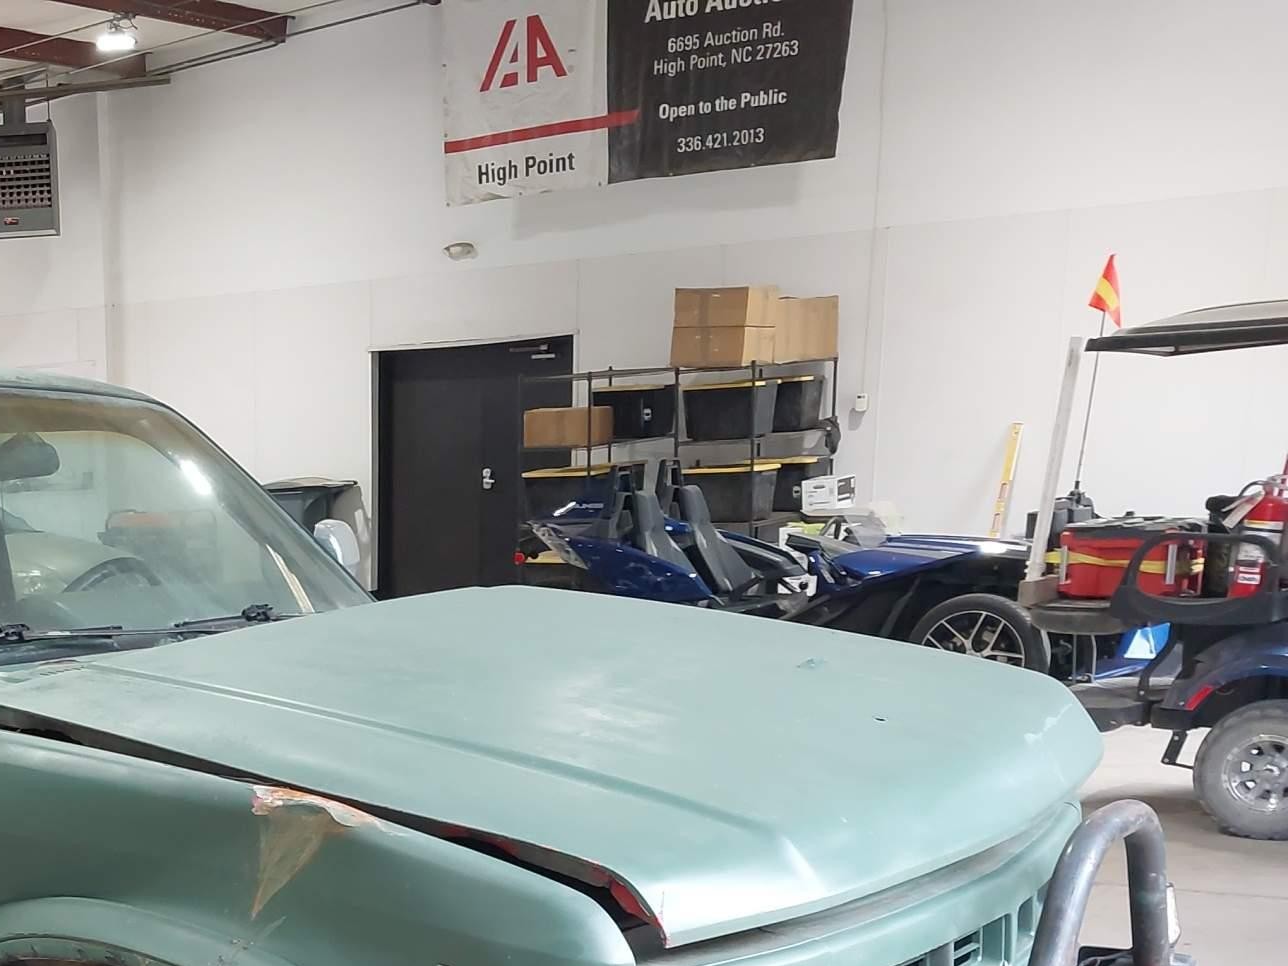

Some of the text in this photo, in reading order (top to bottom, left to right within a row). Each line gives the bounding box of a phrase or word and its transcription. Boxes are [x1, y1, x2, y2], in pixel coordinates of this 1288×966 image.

[644, 0, 698, 23] Auto
[667, 20, 785, 53] 6695 Auction Rd.
[653, 40, 800, 77] High Point, NC 27263
[658, 89, 788, 122] Open to the Public
[676, 128, 765, 152] 336.421.2013
[477, 152, 575, 186] High Point
